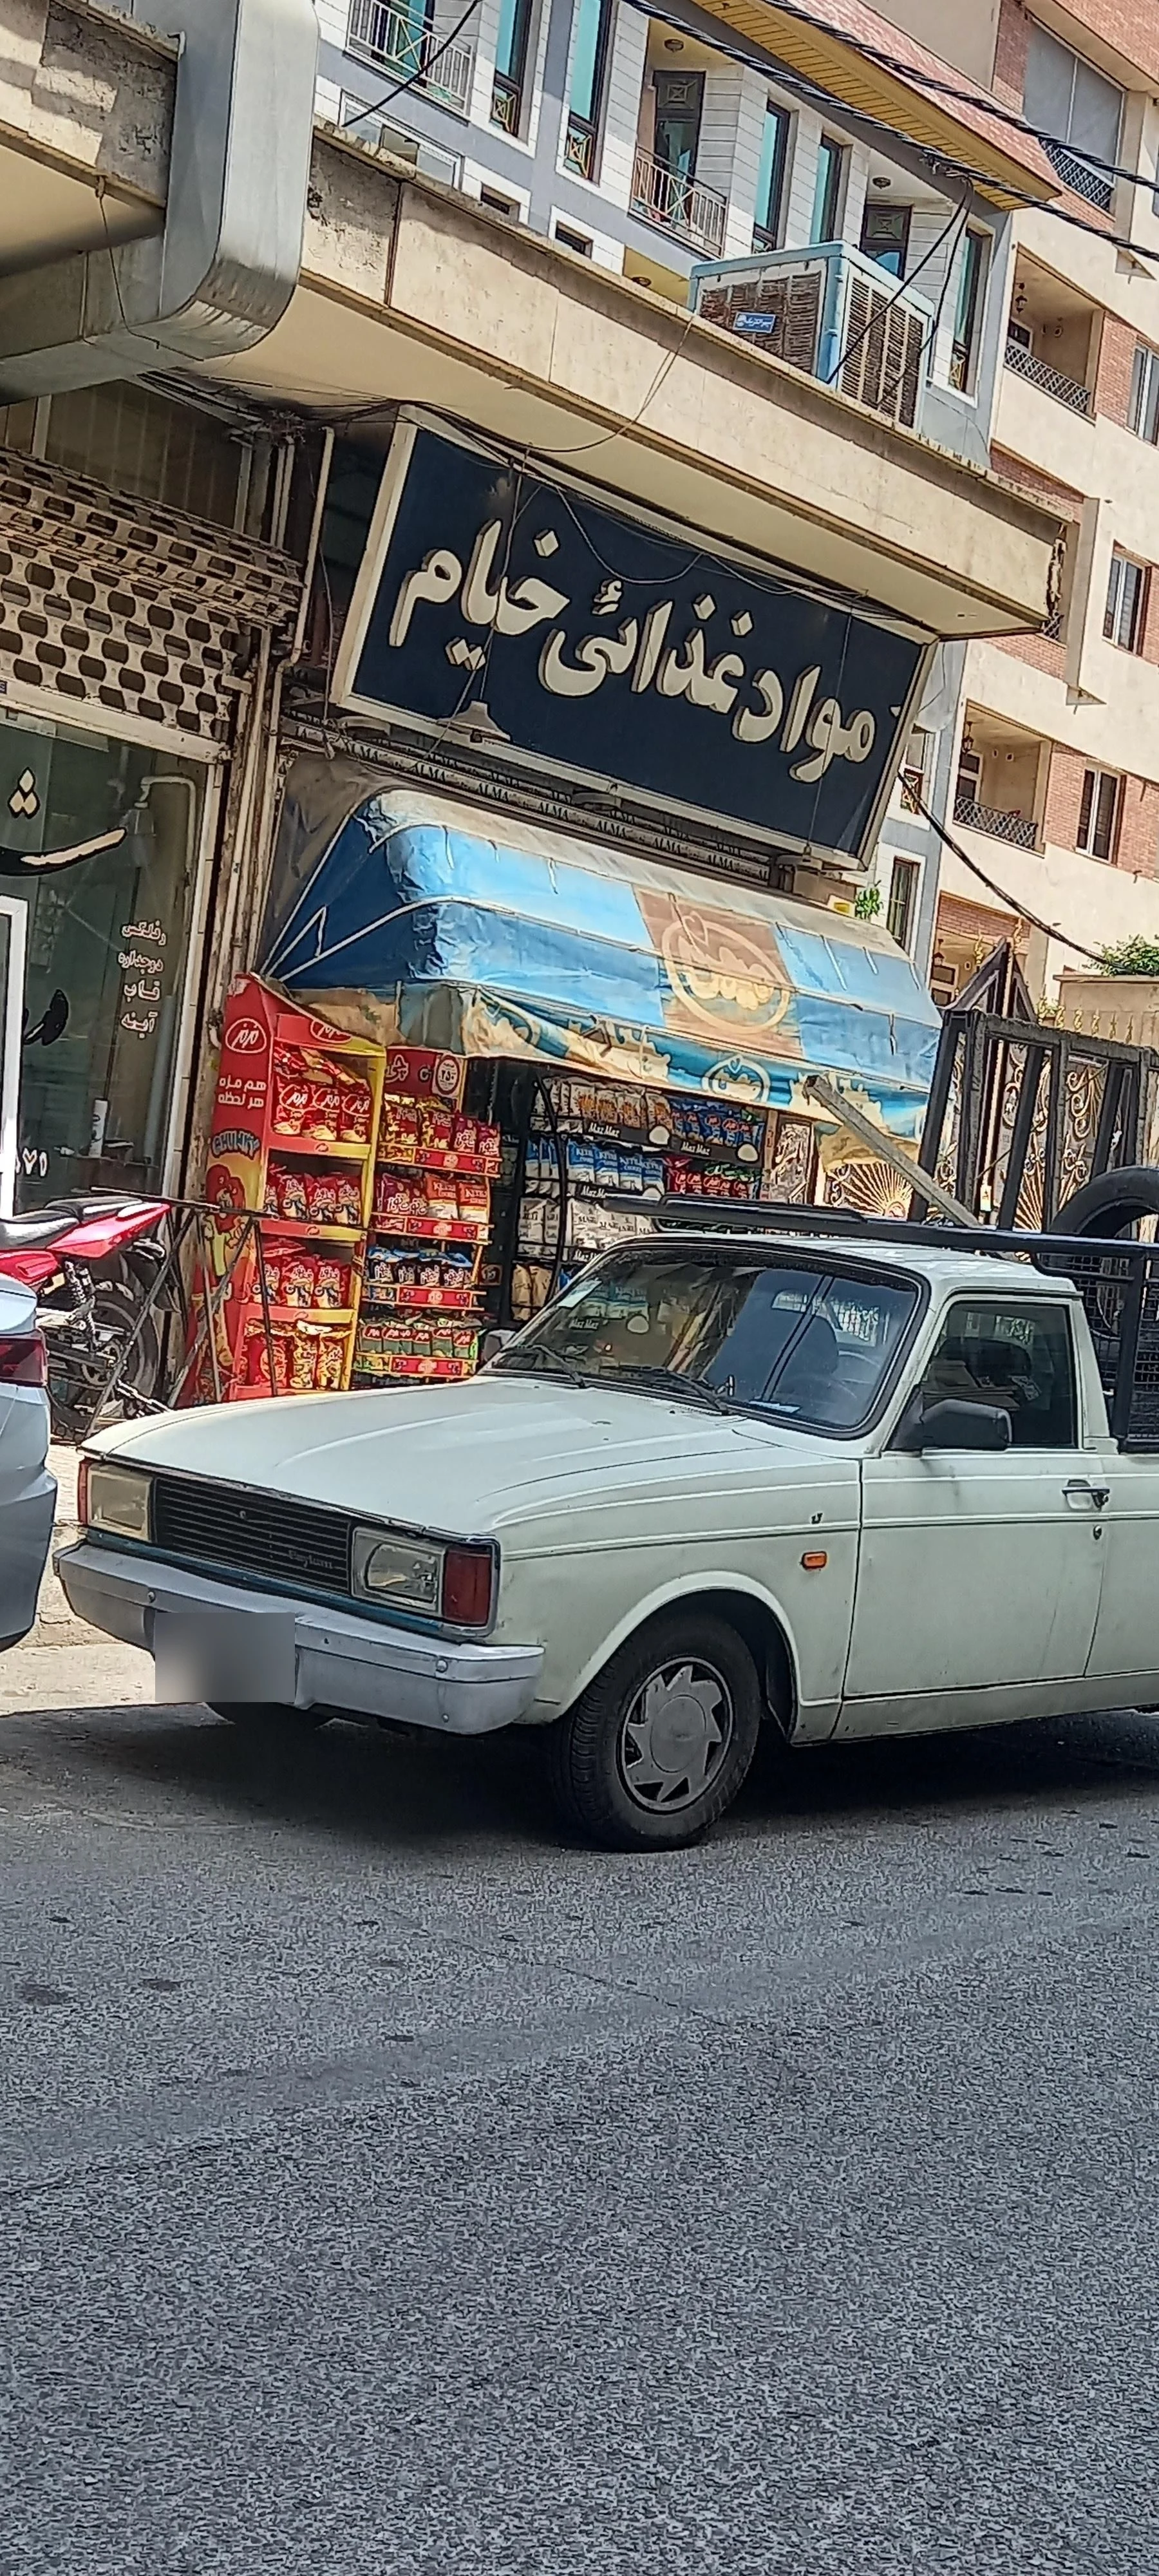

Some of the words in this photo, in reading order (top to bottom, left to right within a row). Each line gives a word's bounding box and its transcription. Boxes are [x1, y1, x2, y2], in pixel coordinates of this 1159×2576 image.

[389, 518, 570, 671] خیام
[538, 578, 755, 716] غذائی
[731, 663, 876, 783] مواد
[118, 950, 164, 974] دوجداره
[121, 1012, 158, 1038] آینه
[219, 1075, 242, 1089] مزه
[244, 1080, 267, 1092] هم
[218, 1092, 245, 1106] لحظه
[247, 1096, 264, 1109] هر
